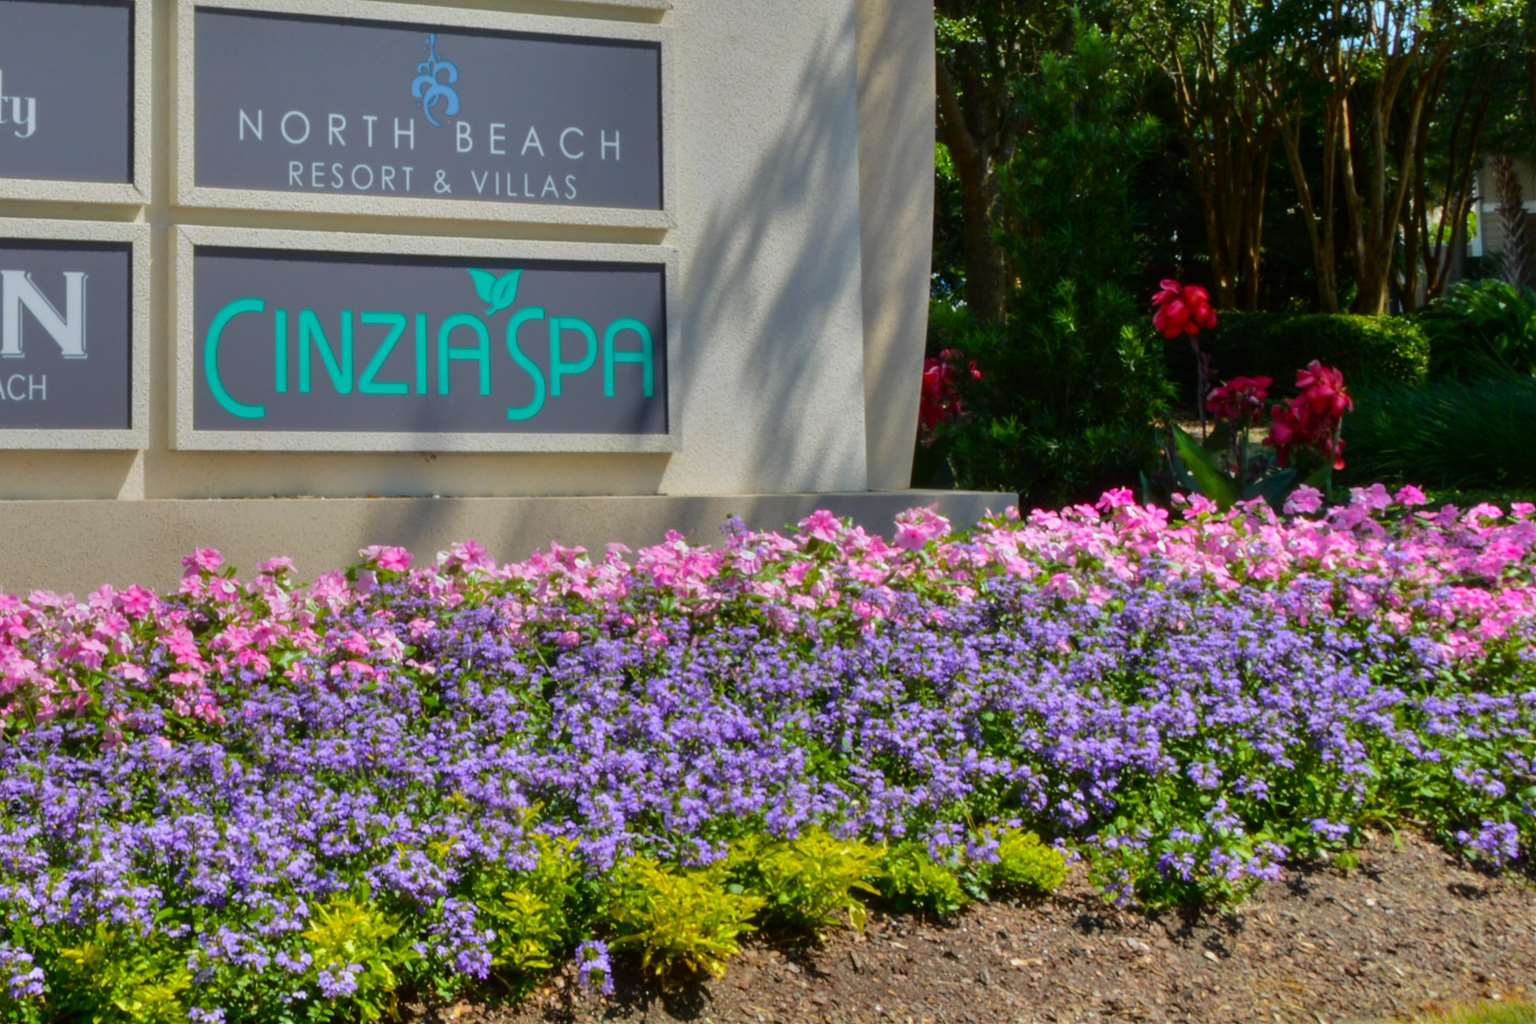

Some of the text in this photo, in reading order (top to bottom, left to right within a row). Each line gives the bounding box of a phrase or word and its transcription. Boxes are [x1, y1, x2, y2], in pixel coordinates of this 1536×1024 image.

[239, 109, 620, 161] NORTH BEACH
[289, 160, 577, 200] RESORT & VILLAS
[204, 297, 654, 421] CINZIA SPA
